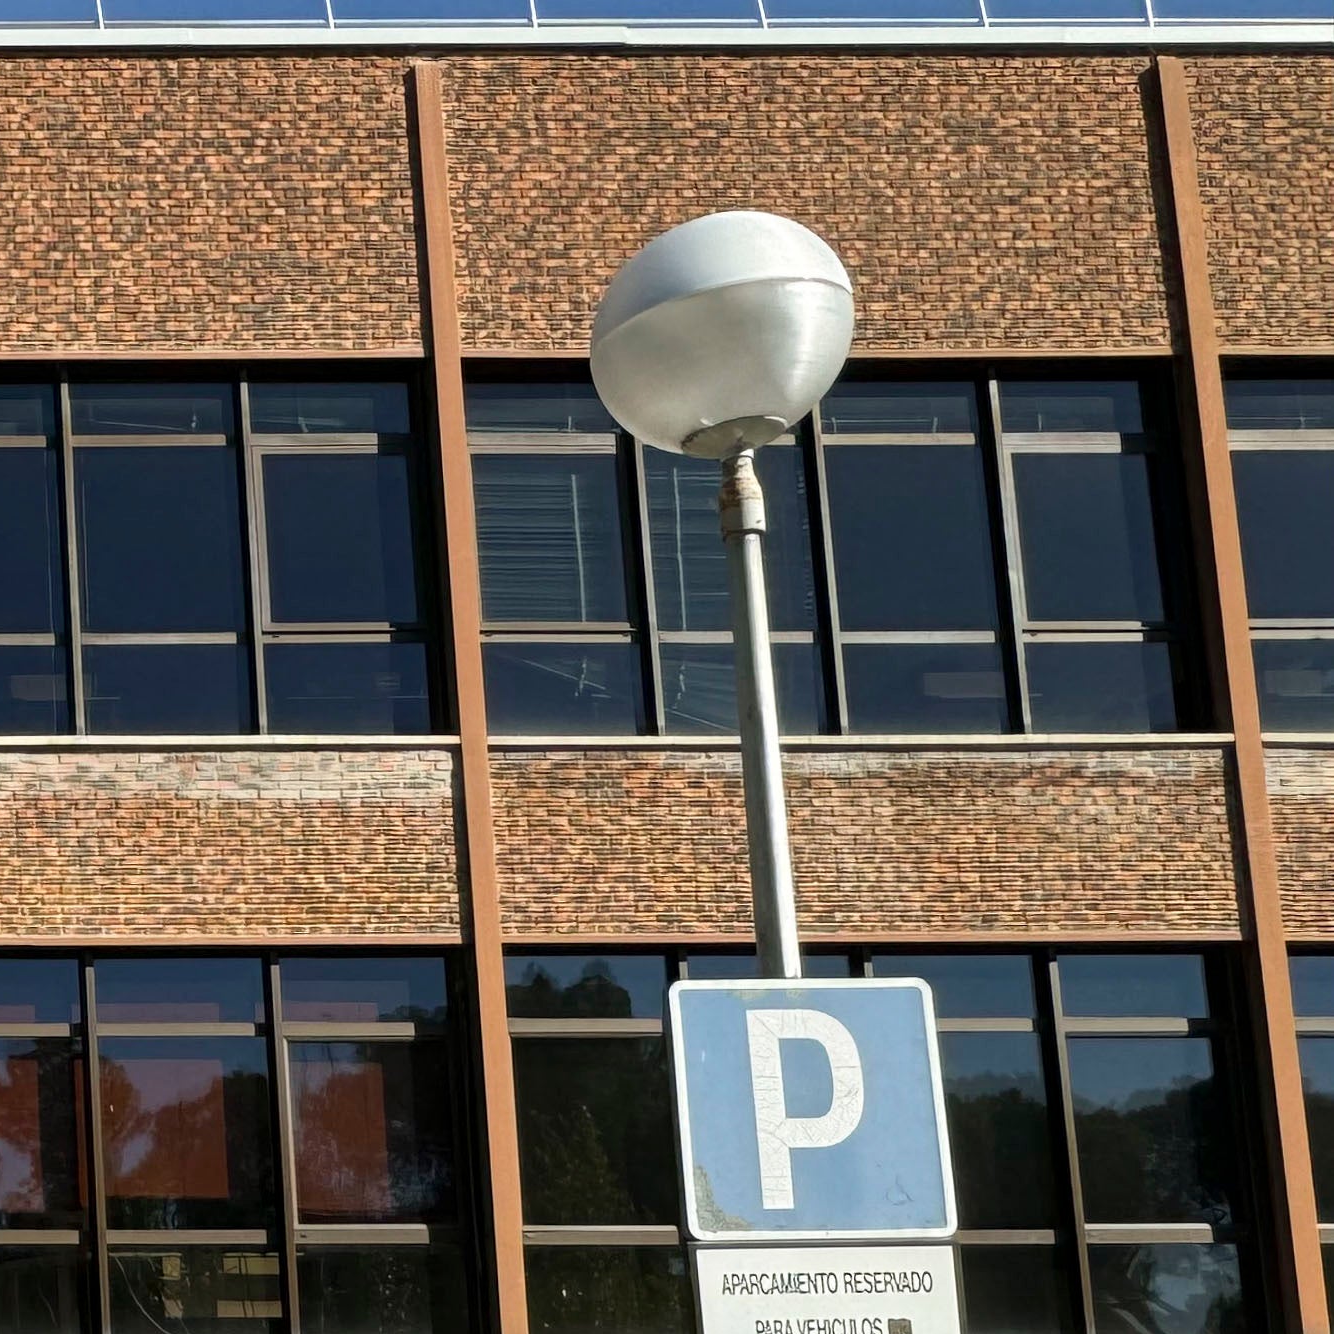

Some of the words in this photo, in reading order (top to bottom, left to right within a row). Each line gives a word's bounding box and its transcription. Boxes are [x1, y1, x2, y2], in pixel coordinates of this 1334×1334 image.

[746, 1009, 864, 1209] P
[722, 1272, 838, 1295] APARCAMIENTO
[844, 1271, 933, 1293] RESERVADO
